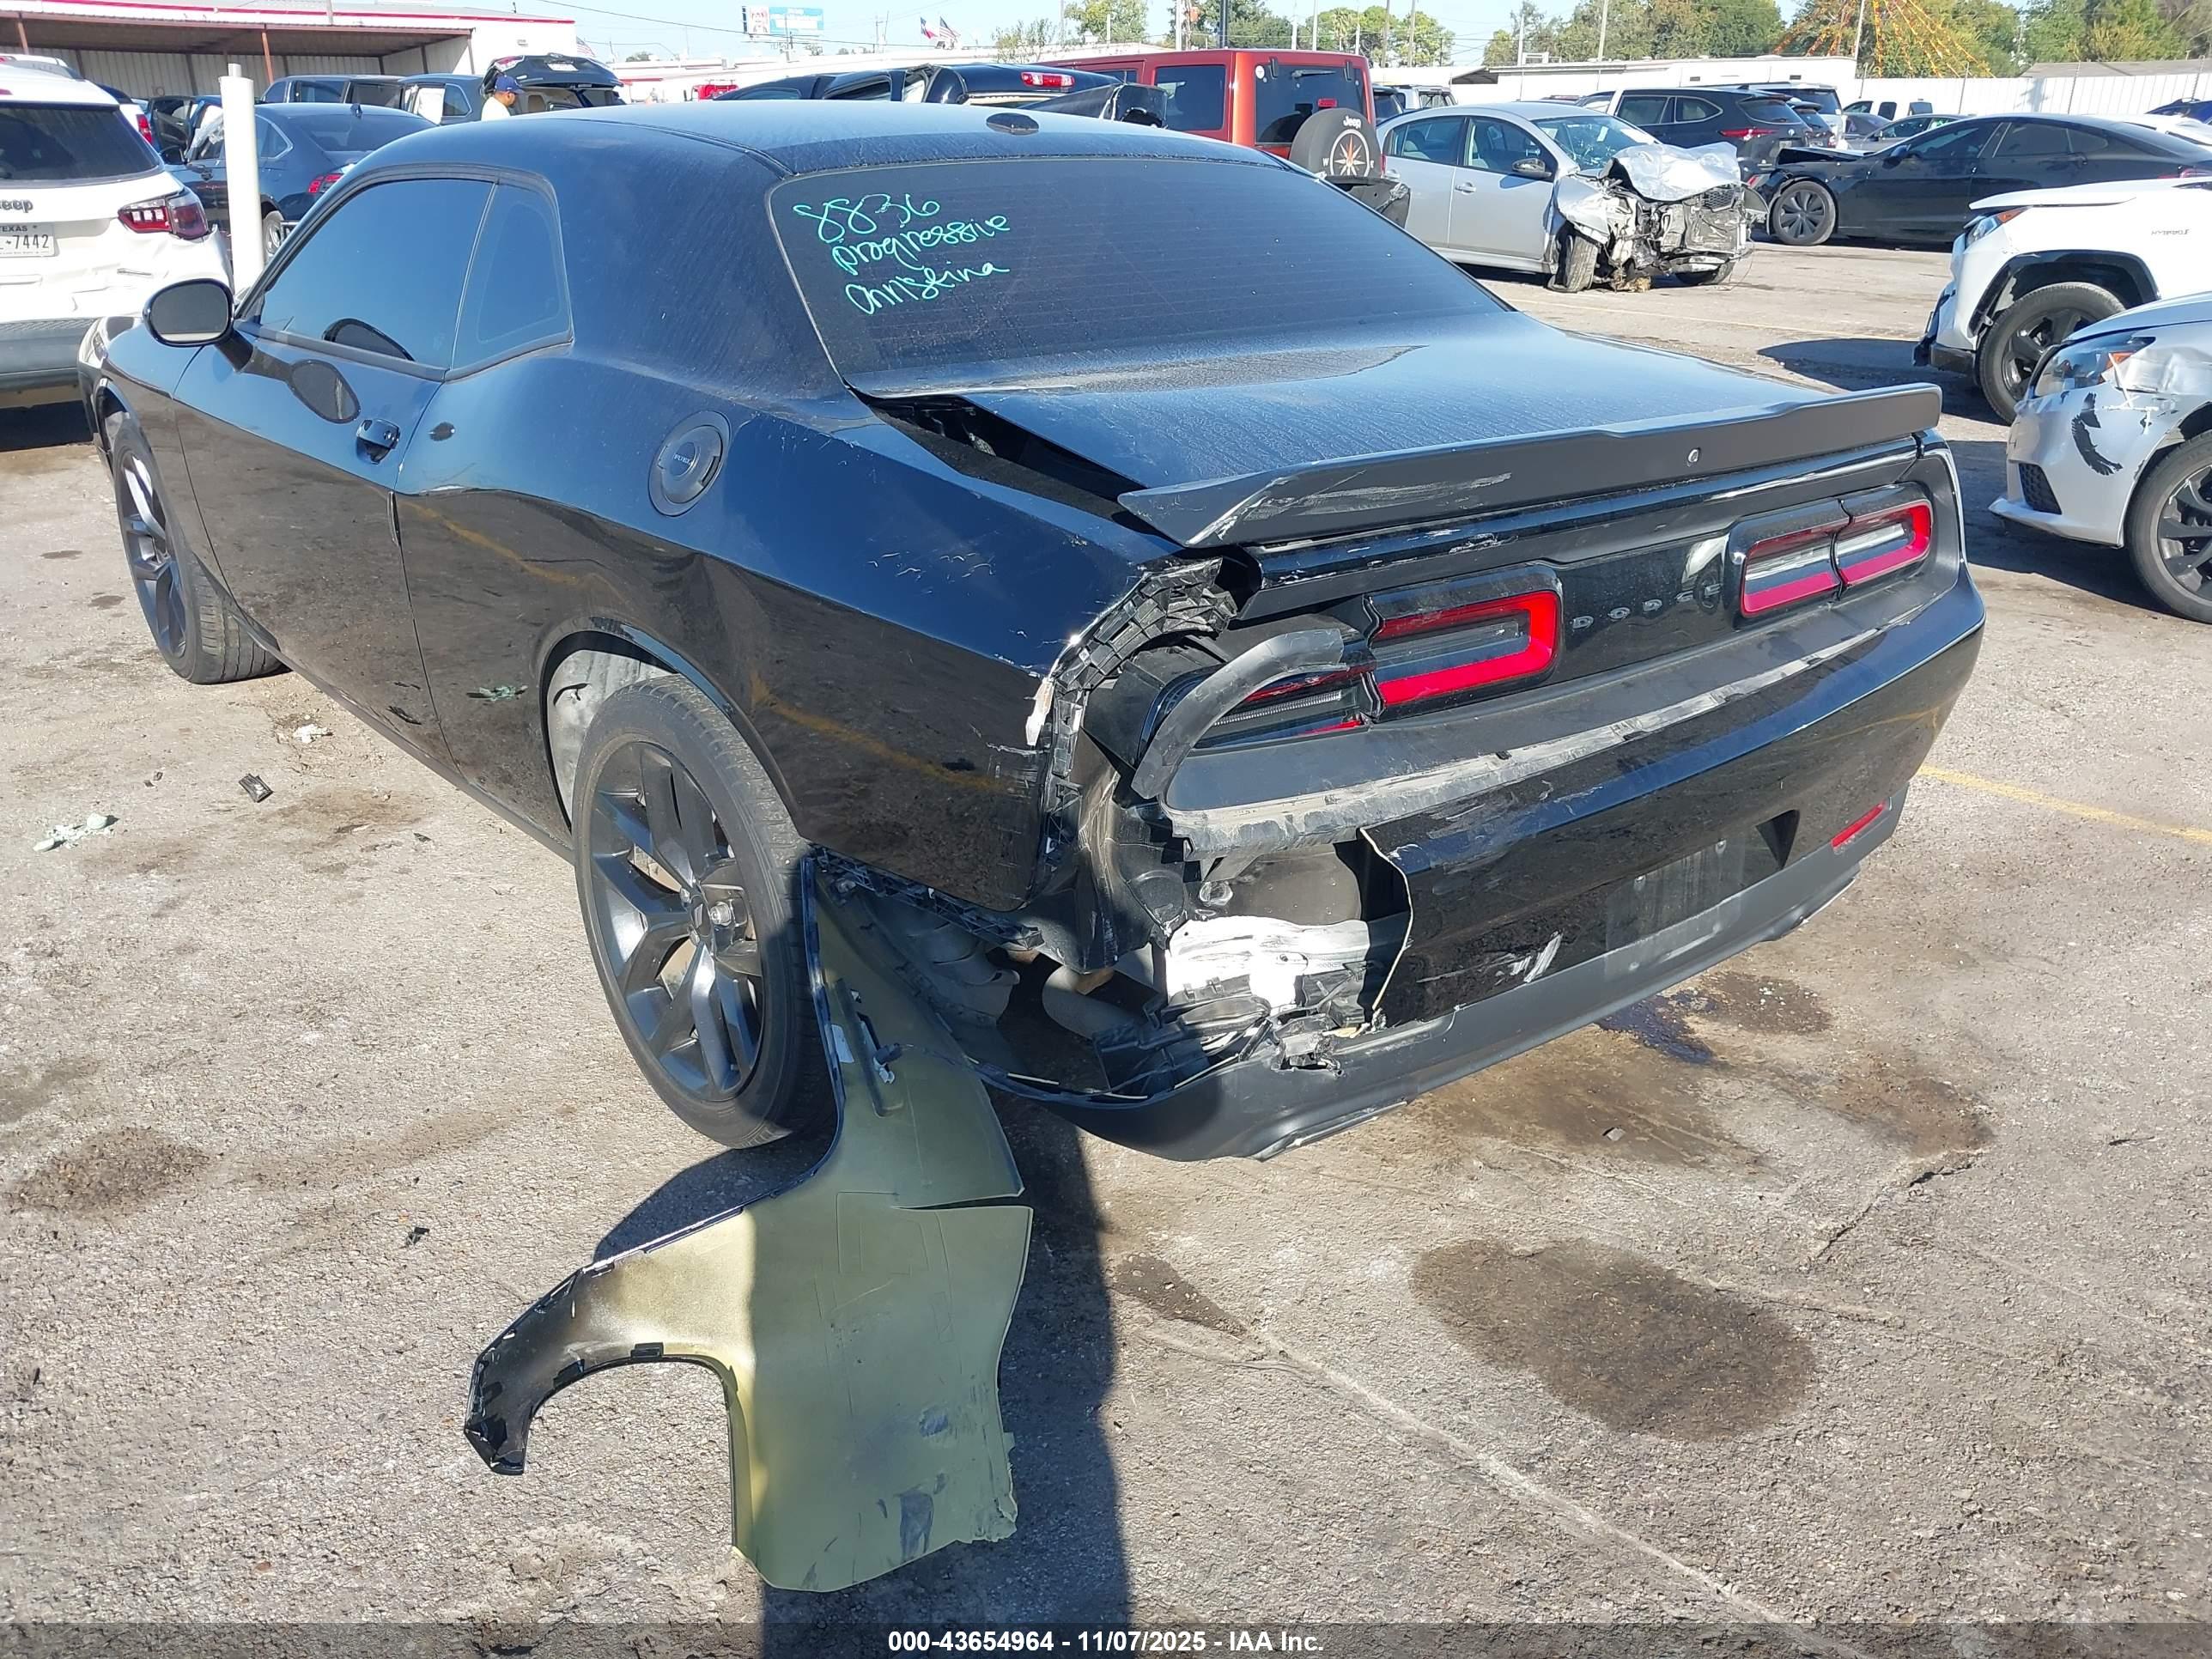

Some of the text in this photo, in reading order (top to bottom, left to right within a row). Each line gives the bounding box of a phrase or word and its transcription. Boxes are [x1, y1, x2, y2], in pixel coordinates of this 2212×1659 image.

[1343, 116, 1362, 129] Jeep
[0, 199, 33, 214] eep
[793, 193, 940, 243] 8836
[1571, 583, 1723, 630] DODGE
